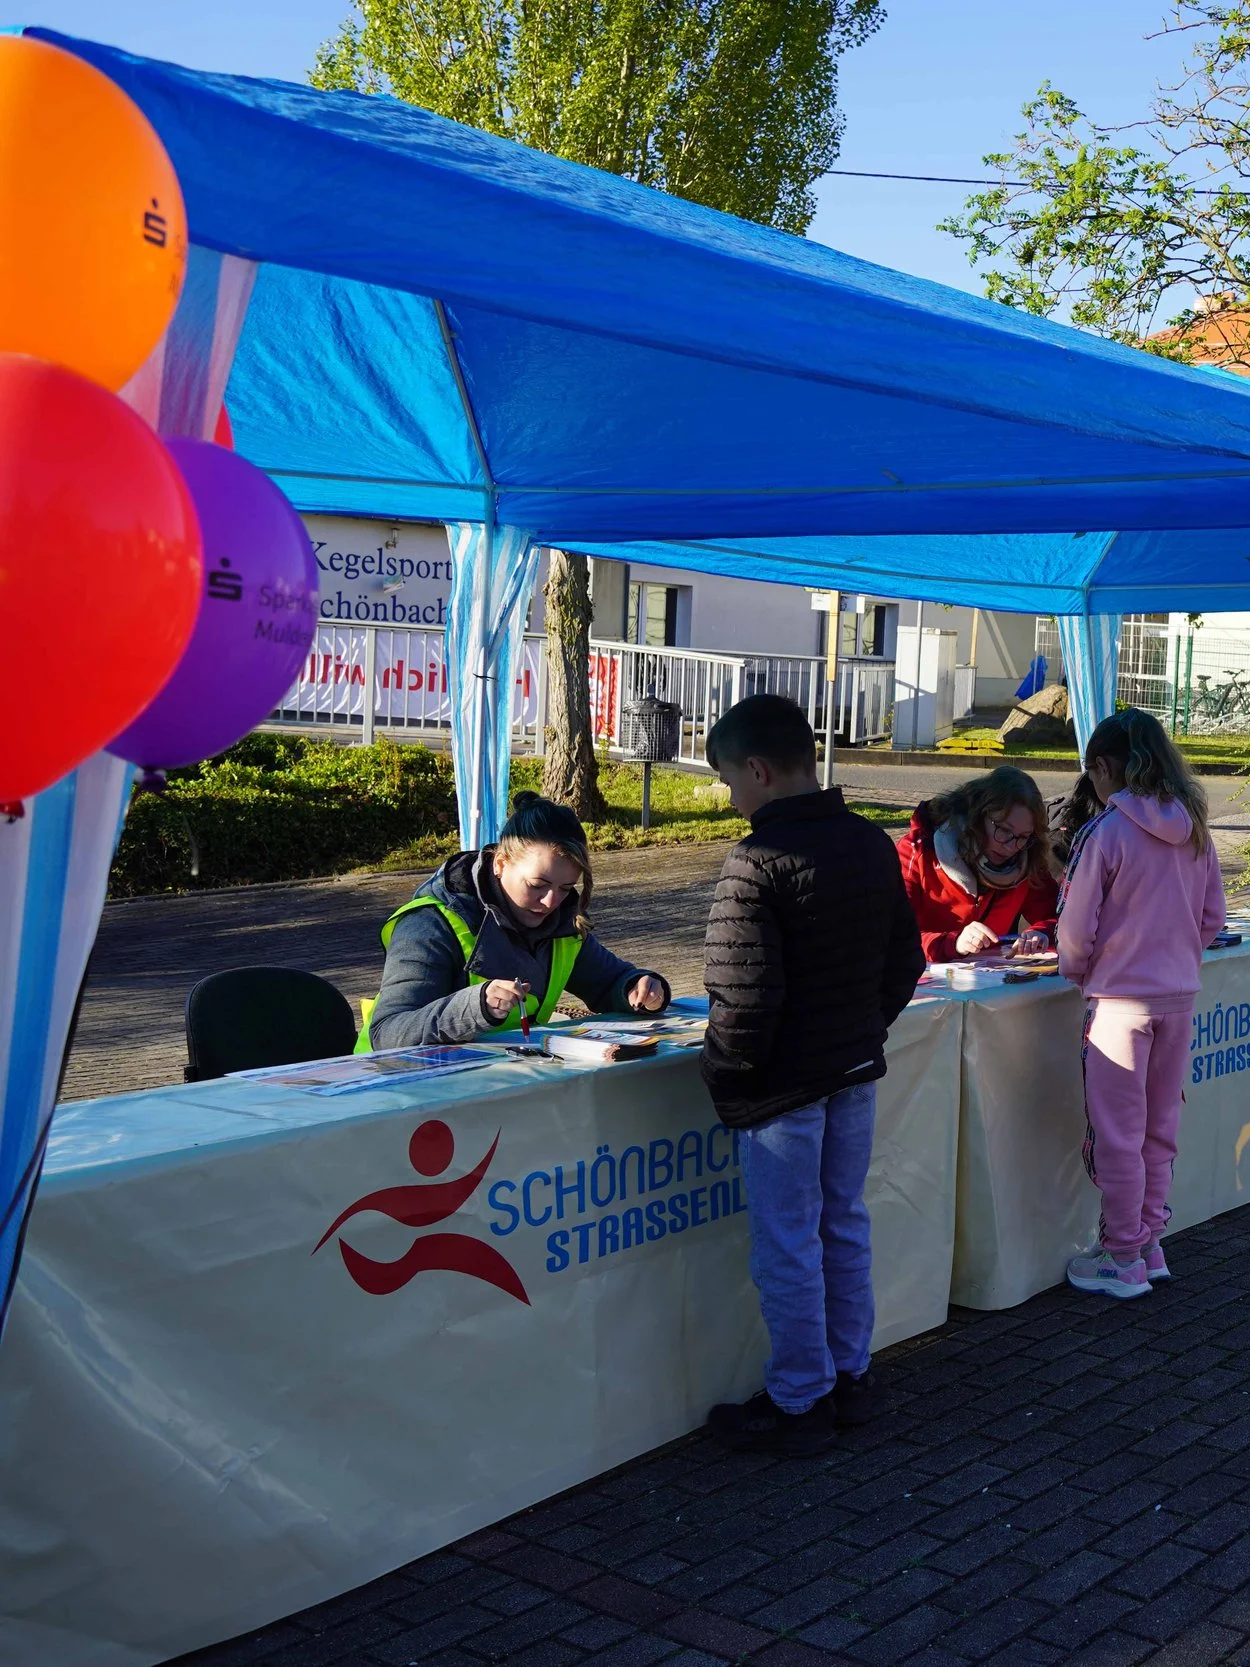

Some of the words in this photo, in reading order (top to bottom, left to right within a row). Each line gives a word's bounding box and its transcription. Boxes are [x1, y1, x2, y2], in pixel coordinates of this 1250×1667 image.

[319, 591, 450, 625] chönbach
[487, 1123, 740, 1237] SCHÖNBAC
[546, 1176, 748, 1274] STRASSENL
